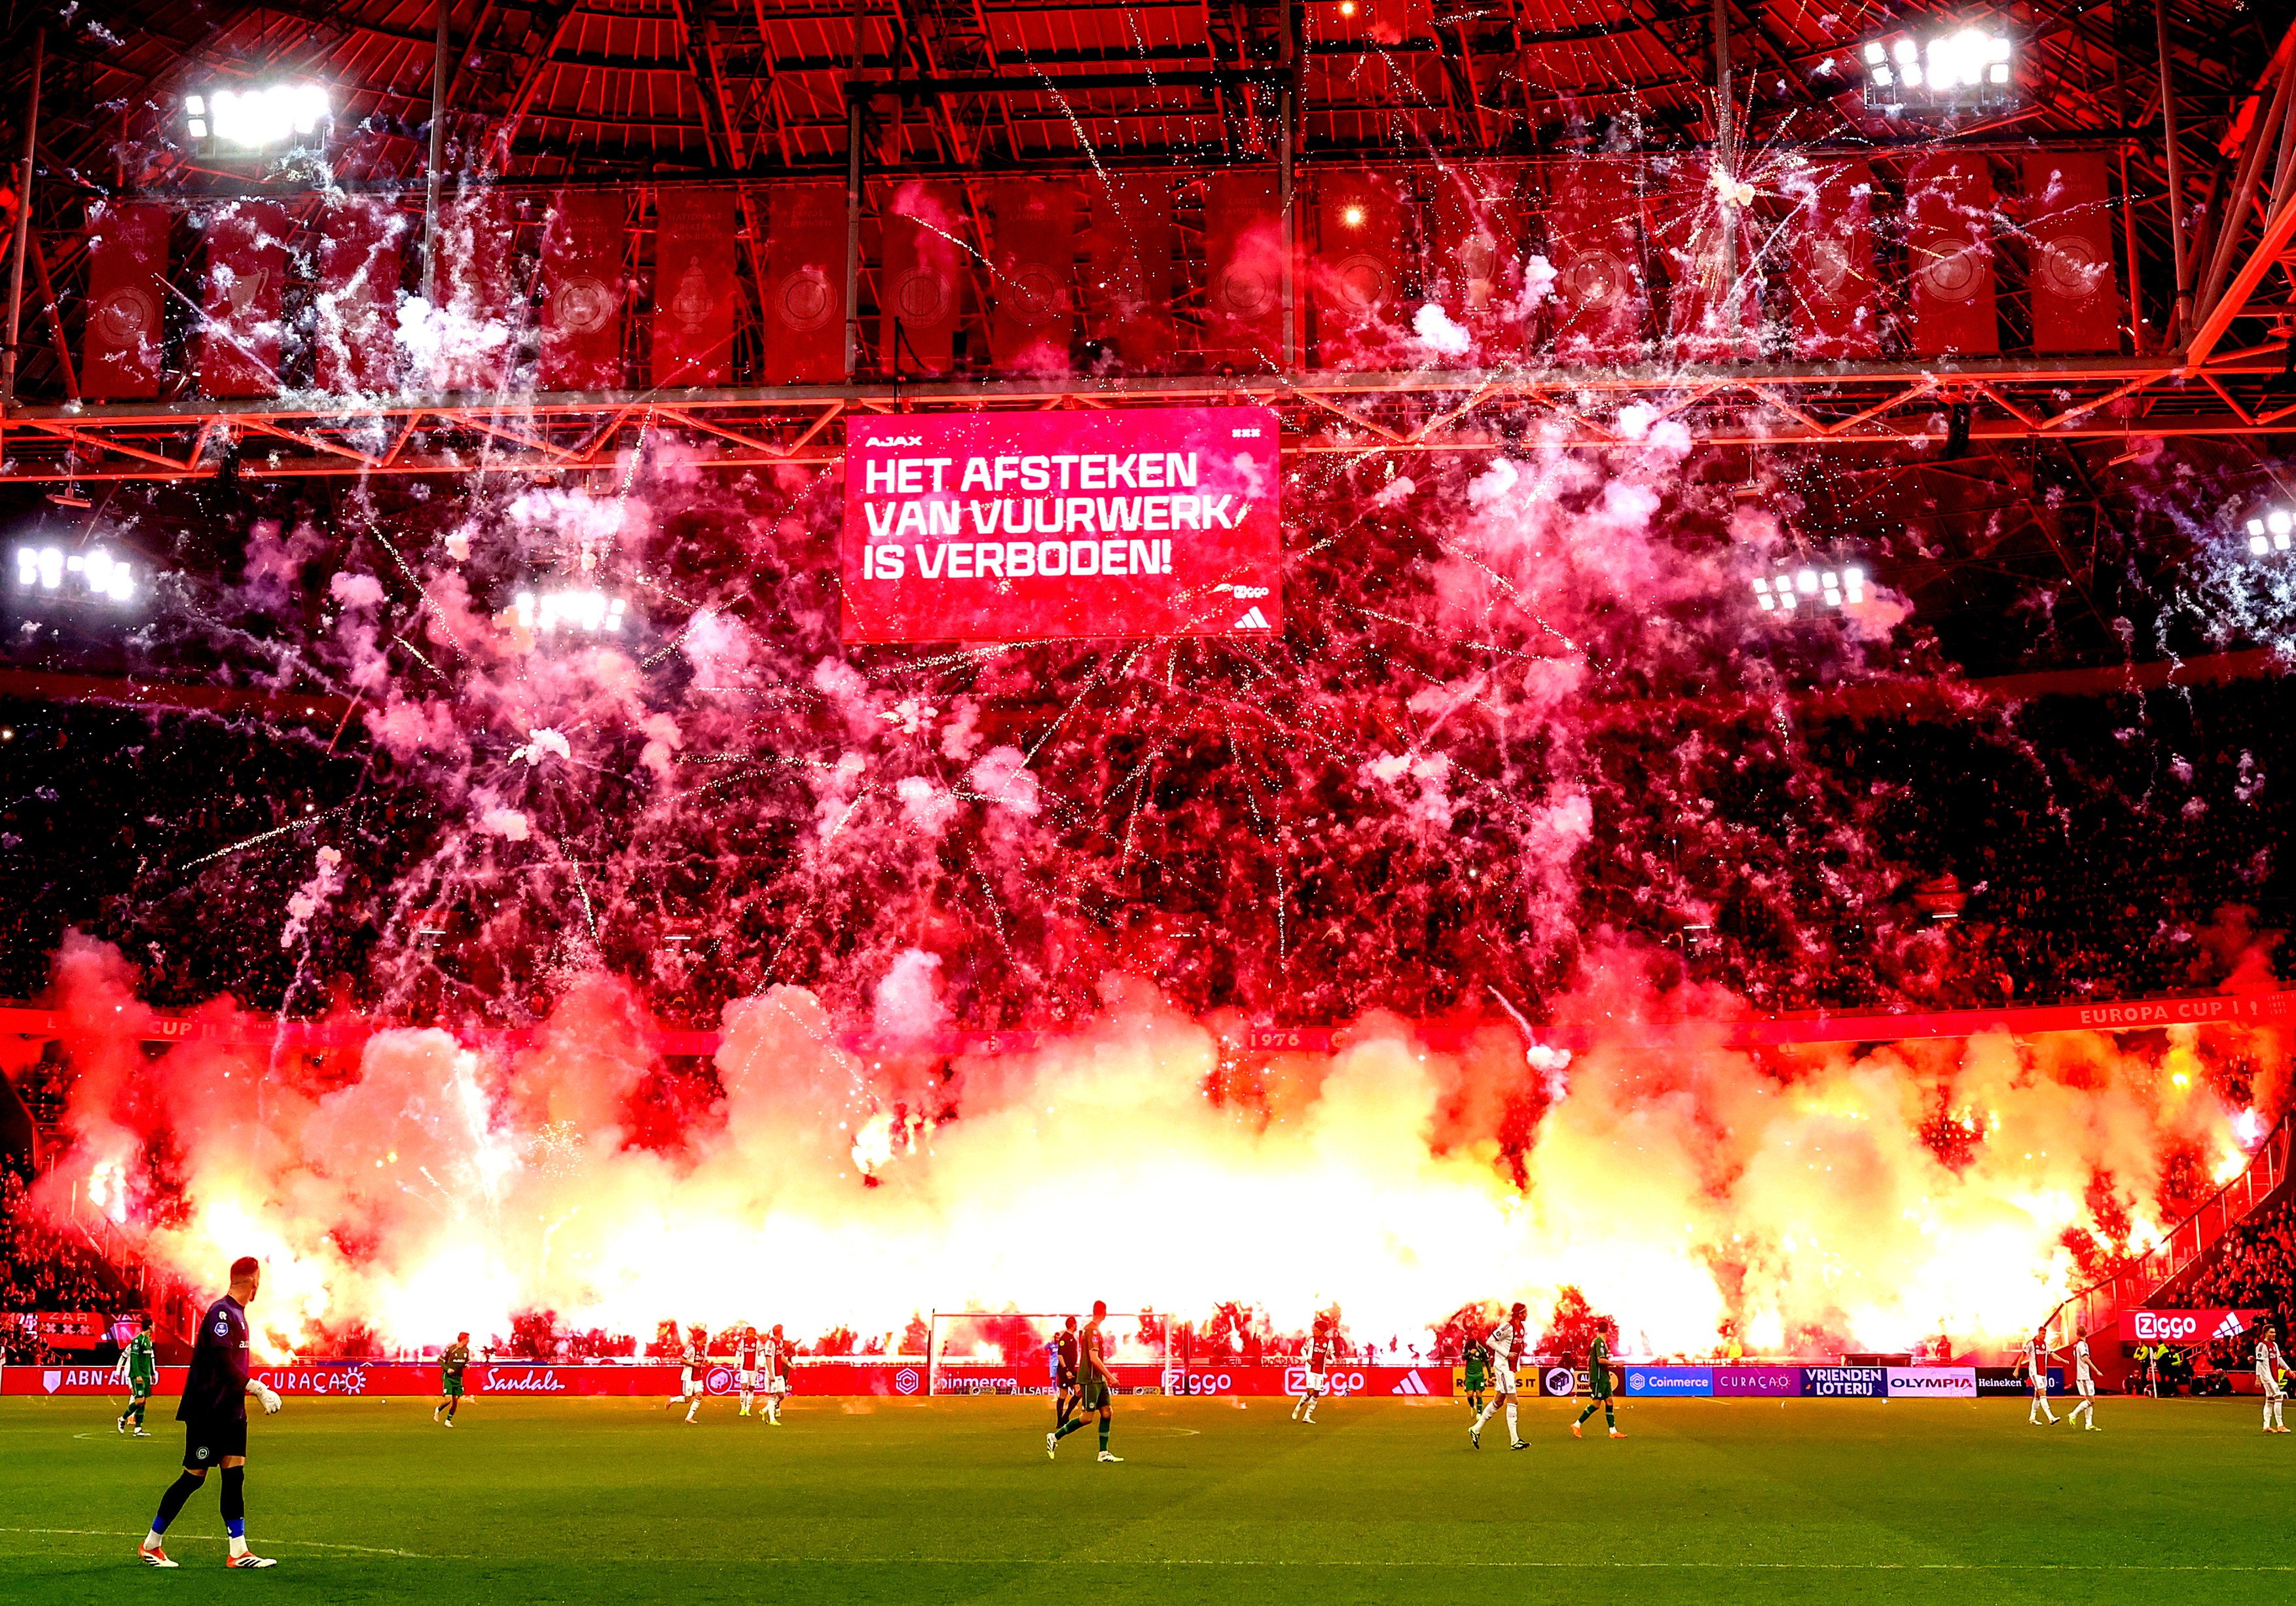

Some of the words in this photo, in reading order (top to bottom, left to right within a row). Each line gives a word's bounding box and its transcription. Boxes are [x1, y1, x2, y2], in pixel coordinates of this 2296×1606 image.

[866, 435, 922, 447] AJAX
[866, 458, 951, 493] HET
[961, 452, 1197, 491] AFSTEKEN
[864, 500, 960, 537] VAN
[972, 494, 1233, 534] VUURWERK
[864, 544, 904, 579] IS
[916, 539, 1172, 579] VERBODEN!
[2081, 1005, 2168, 1024] EUROPA
[2178, 1002, 2223, 1017] CUP
[147, 1021, 192, 1035] CUP
[1250, 1034, 1300, 1046] 1976
[483, 1368, 565, 1391] Sandals
[937, 1374, 1017, 1389] oinmerce
[1649, 1376, 1709, 1387] Coinmerce
[1806, 1369, 1882, 1381] VRIENDEN
[1525, 1379, 1535, 1387] IT
[1816, 1379, 1873, 1396] LOTERIJ
[1891, 1378, 1973, 1389] OLYMPIA
[1978, 1378, 2022, 1387] Heineken
